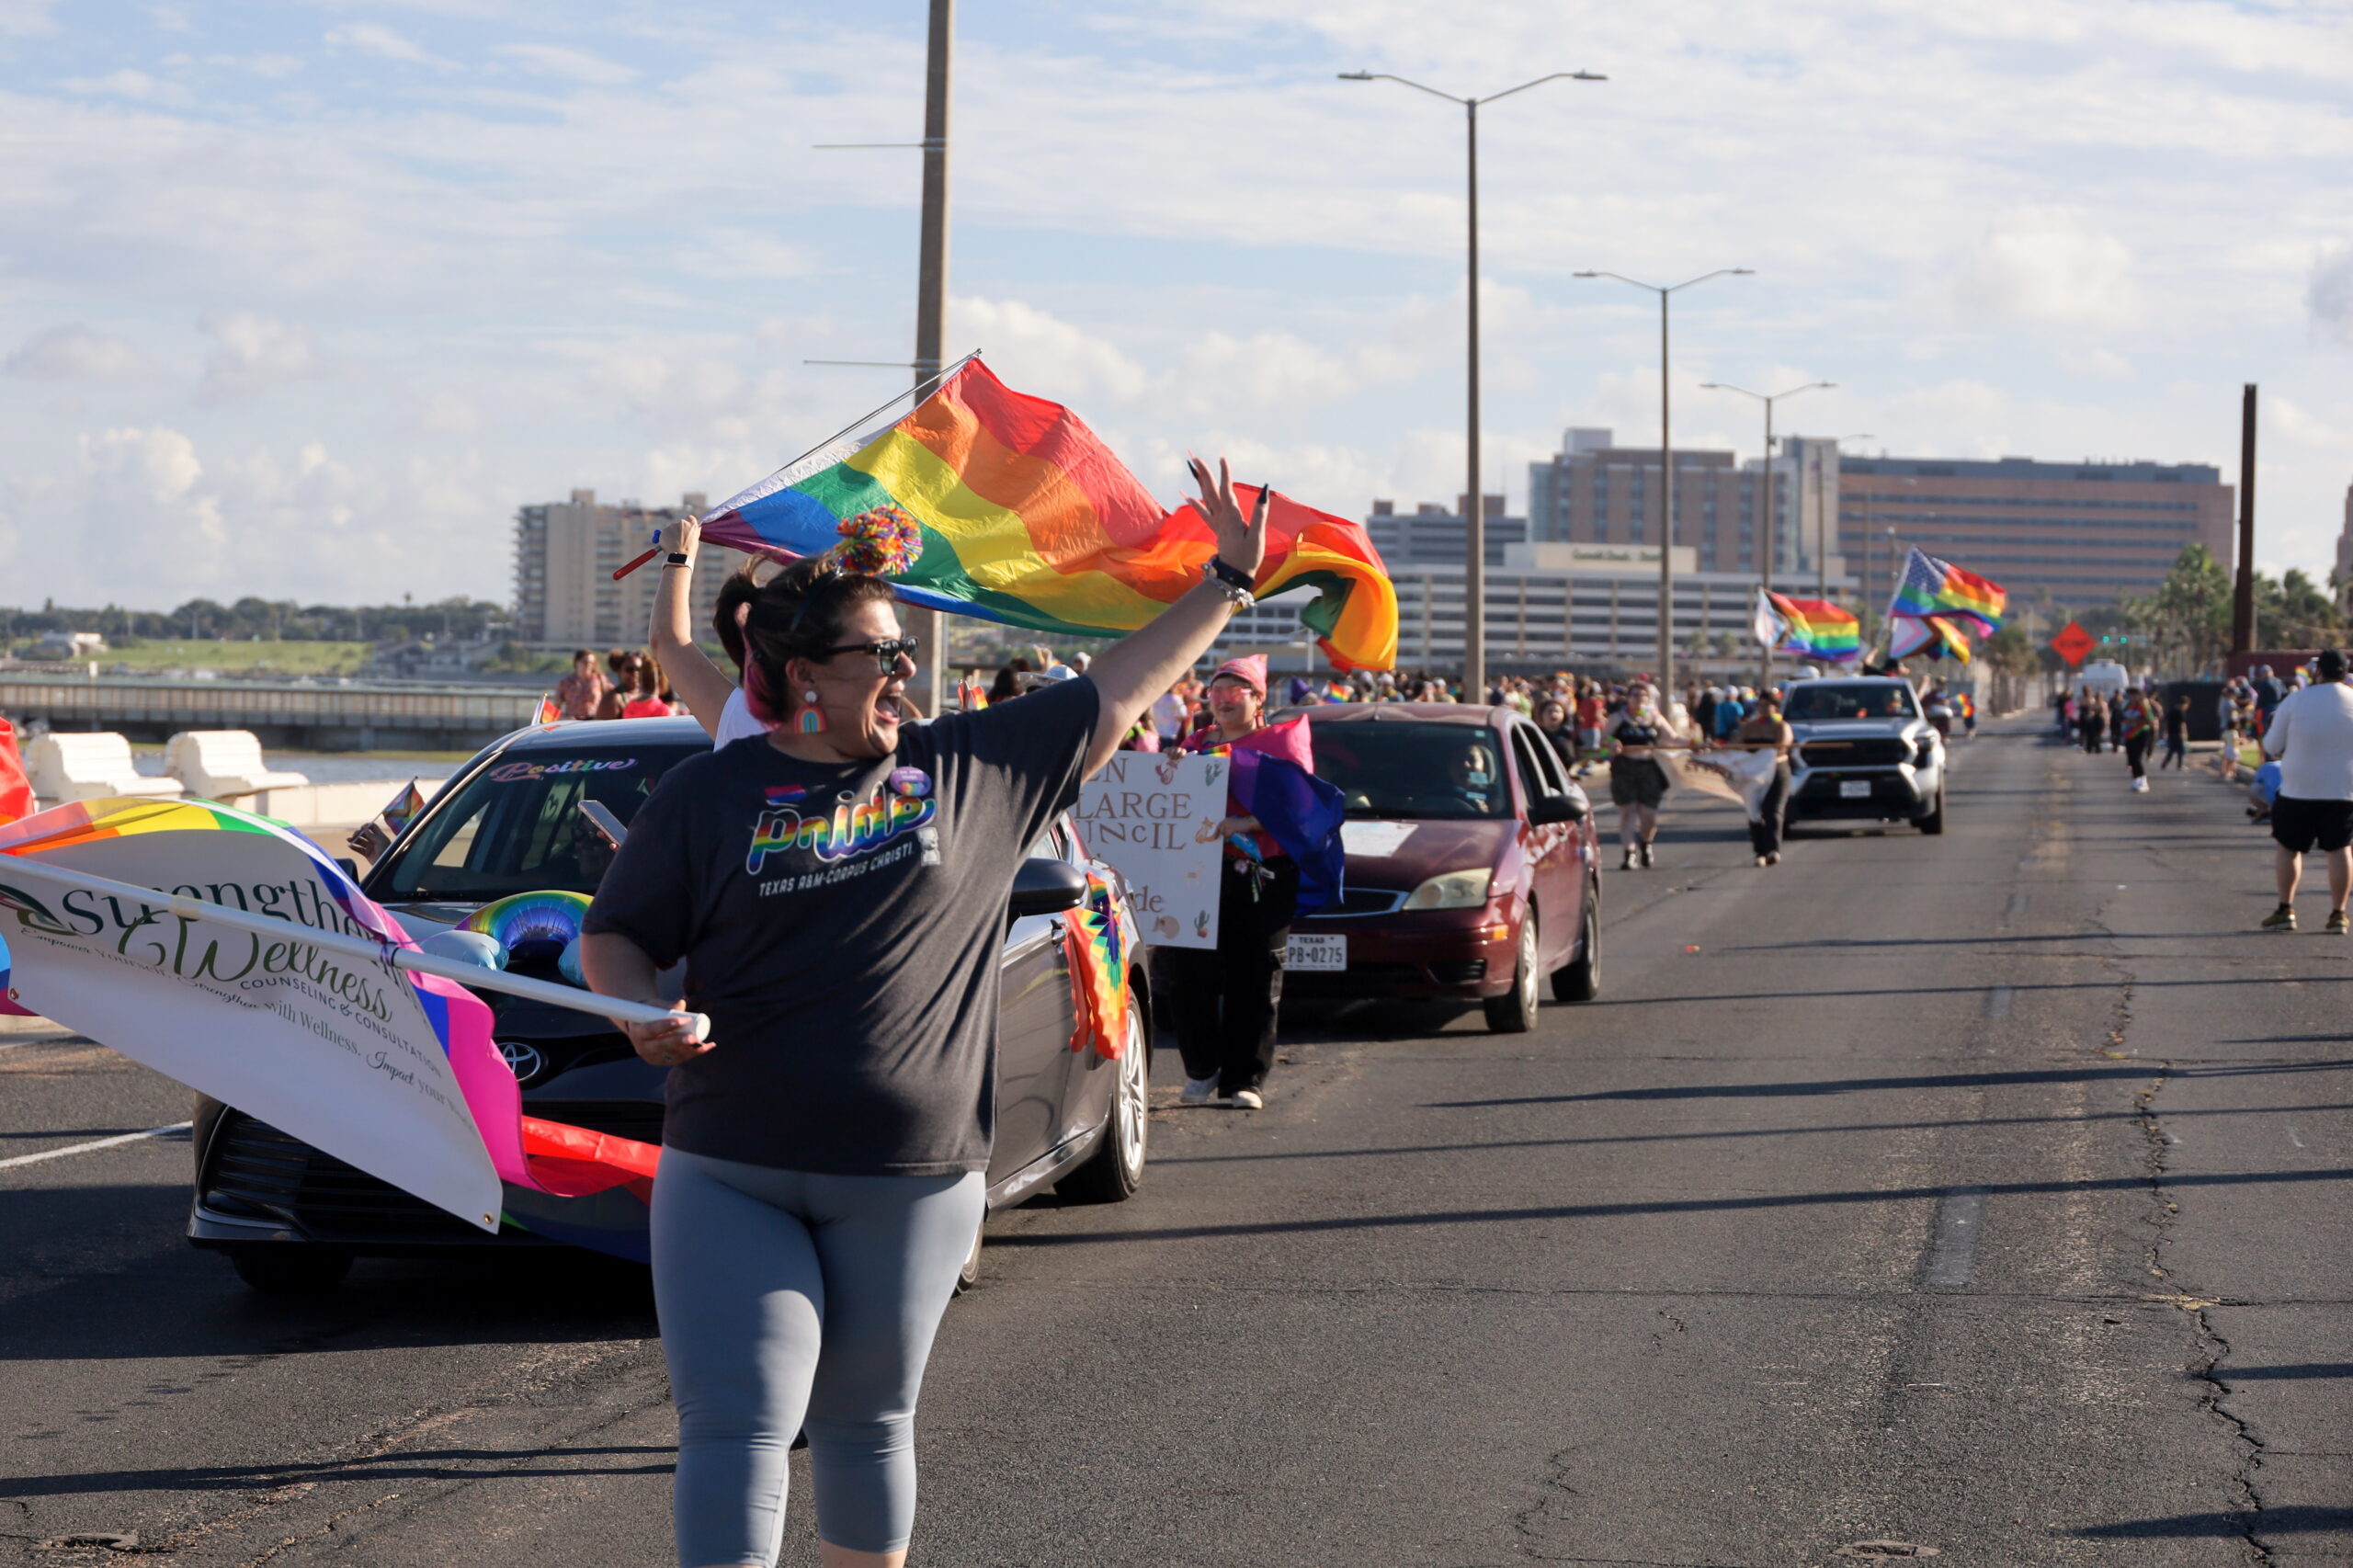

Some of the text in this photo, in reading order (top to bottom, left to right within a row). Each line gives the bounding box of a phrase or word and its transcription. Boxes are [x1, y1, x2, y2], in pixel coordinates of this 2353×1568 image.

[489, 757, 639, 782] Positive
[1074, 791, 1192, 820] LARGE
[759, 841, 914, 897] TEXAS A&M-CORPUS CHRISTI
[1299, 936, 1325, 944] TEXAS
[117, 909, 393, 1023] Wellness
[240, 976, 337, 1010] COUNSELING
[339, 1003, 353, 1017] &
[300, 1011, 361, 1057] Wellness.
[366, 1051, 414, 1085] Impact
